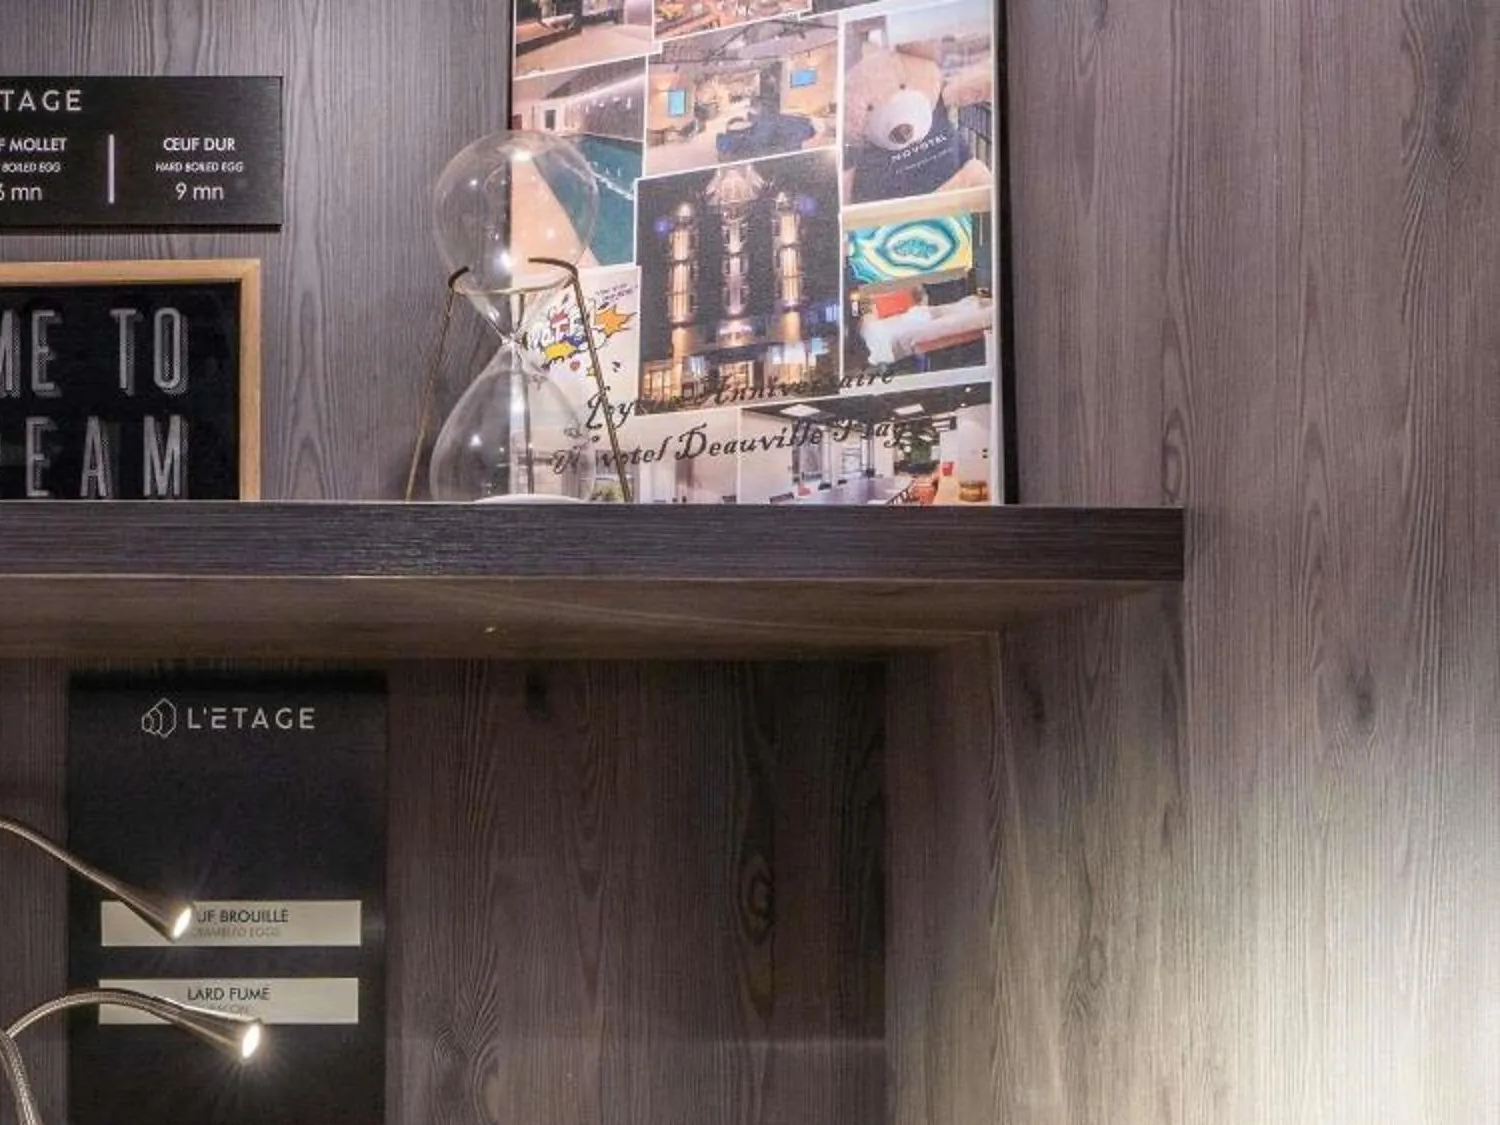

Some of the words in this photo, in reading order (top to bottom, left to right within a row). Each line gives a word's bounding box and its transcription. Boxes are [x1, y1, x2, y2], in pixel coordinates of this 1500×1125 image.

[9, 137, 68, 152] MOLLET
[203, 137, 236, 151] DUR
[2, 162, 37, 173] BOILED
[39, 161, 61, 173] EGG
[155, 162, 183, 173] HARD
[185, 162, 220, 173] BOILED
[221, 161, 244, 173] EGG
[11, 186, 42, 201] mn
[175, 181, 187, 200] 9
[193, 186, 225, 201] mn
[110, 306, 184, 392] TO
[187, 986, 226, 1001] LARD
